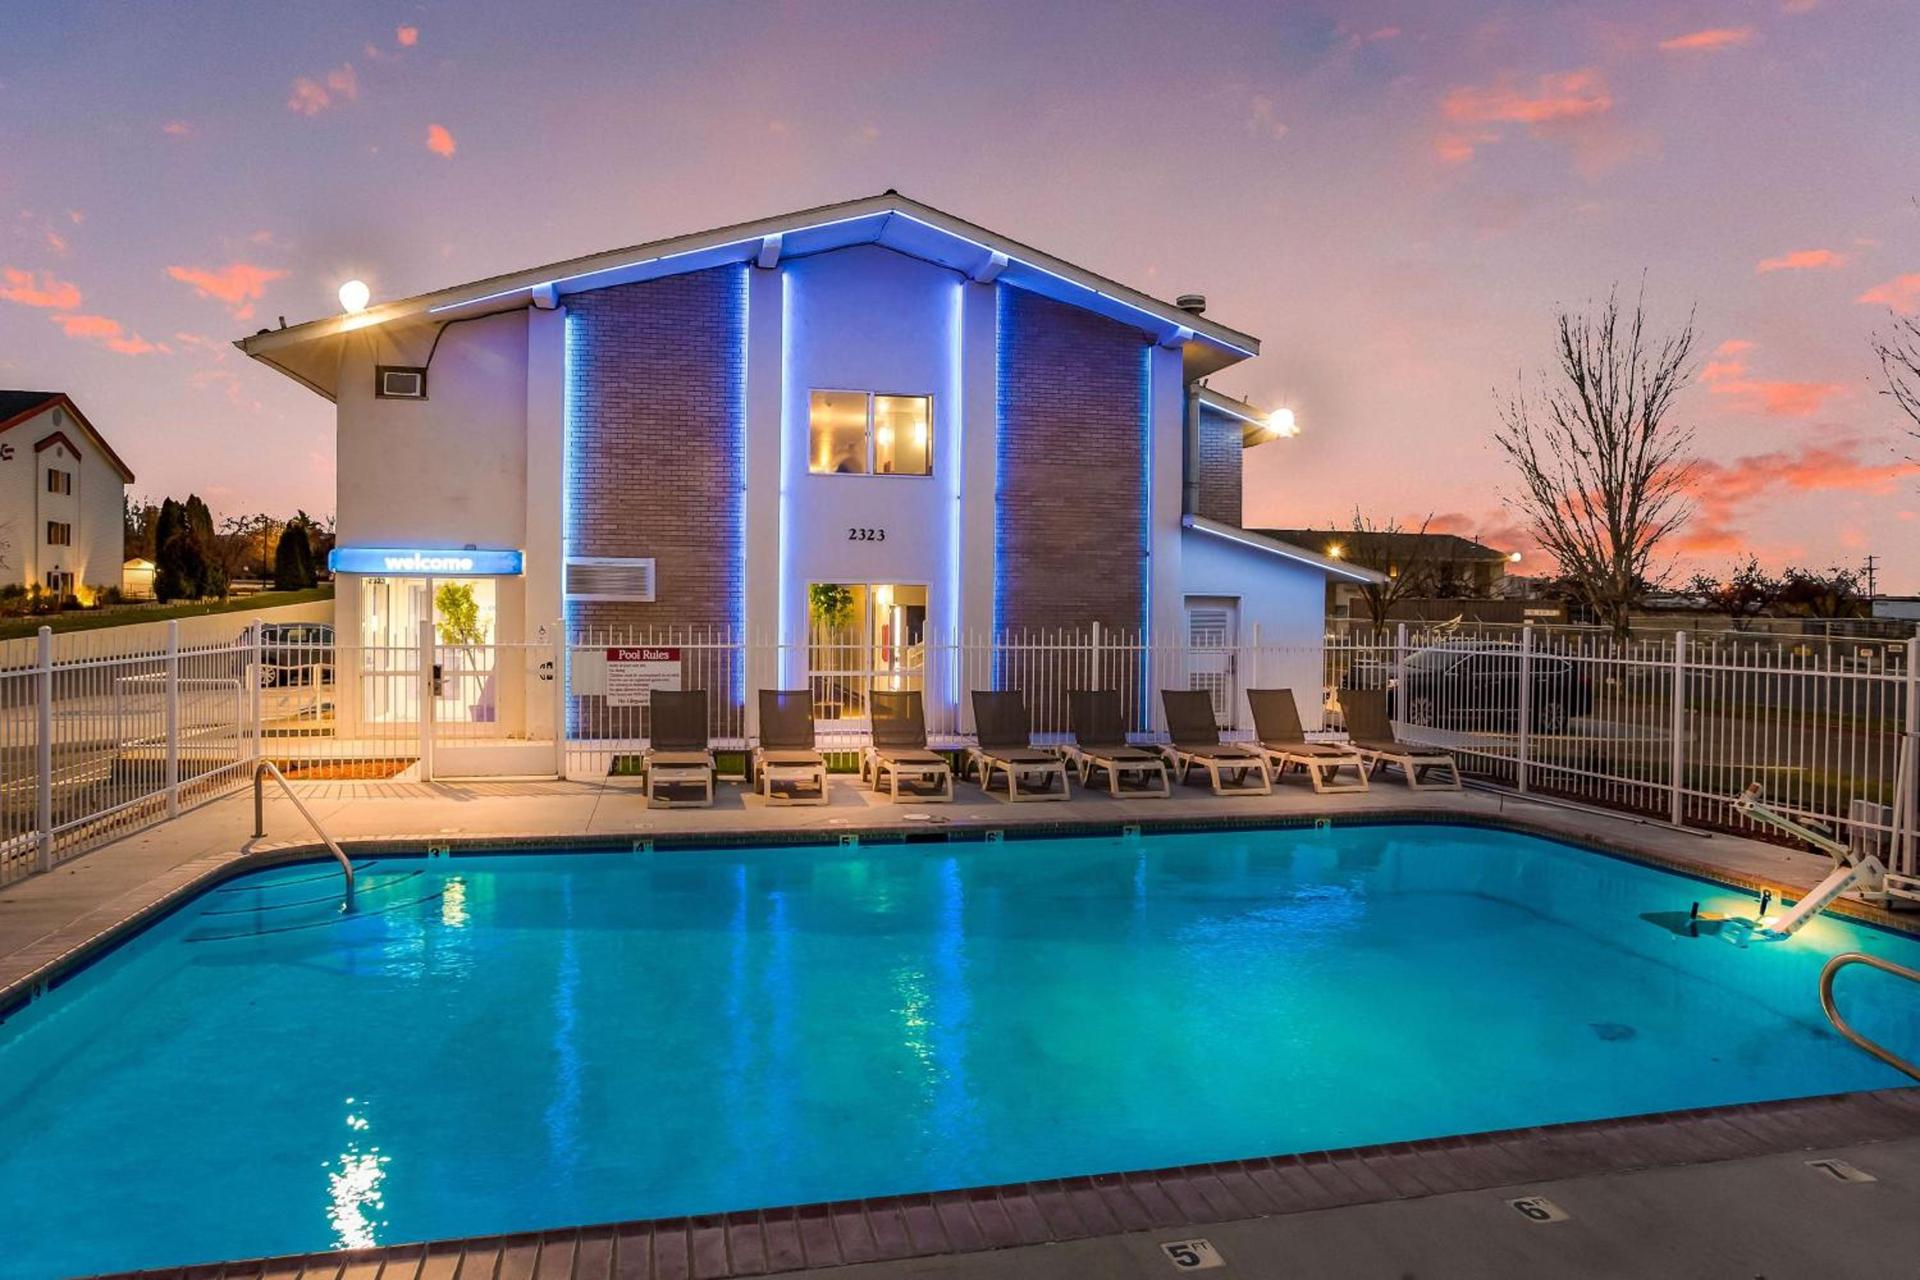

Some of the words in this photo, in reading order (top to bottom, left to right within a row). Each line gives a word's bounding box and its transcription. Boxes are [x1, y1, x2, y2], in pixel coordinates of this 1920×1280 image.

[848, 528, 886, 542] 2323
[384, 553, 474, 572] welcome
[618, 649, 641, 660] Pool
[642, 649, 670, 660] Rules
[1811, 1163, 1849, 1179] 7
[1514, 1201, 1551, 1220] 6
[1167, 1244, 1201, 1266] 5
[1191, 1242, 1208, 1252] FT
